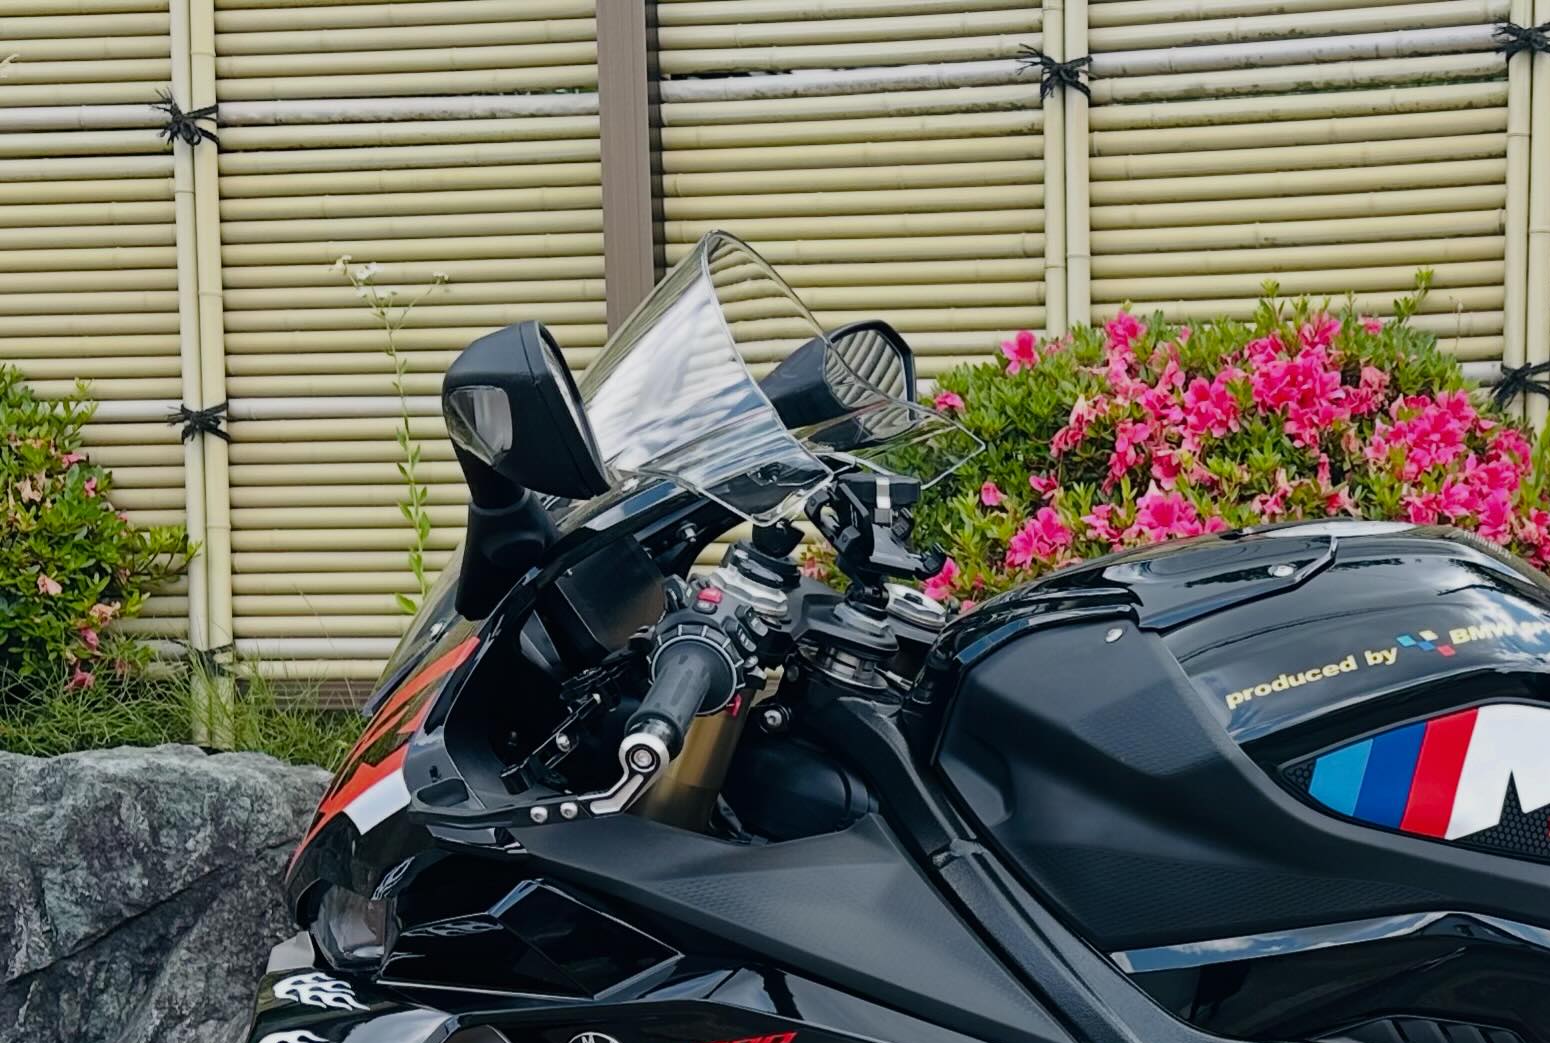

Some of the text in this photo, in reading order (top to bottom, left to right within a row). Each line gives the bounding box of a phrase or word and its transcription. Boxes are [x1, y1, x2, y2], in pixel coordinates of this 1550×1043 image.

[1224, 655, 1357, 709] produced
[1365, 647, 1397, 667] by
[1449, 623, 1513, 645] BMW
